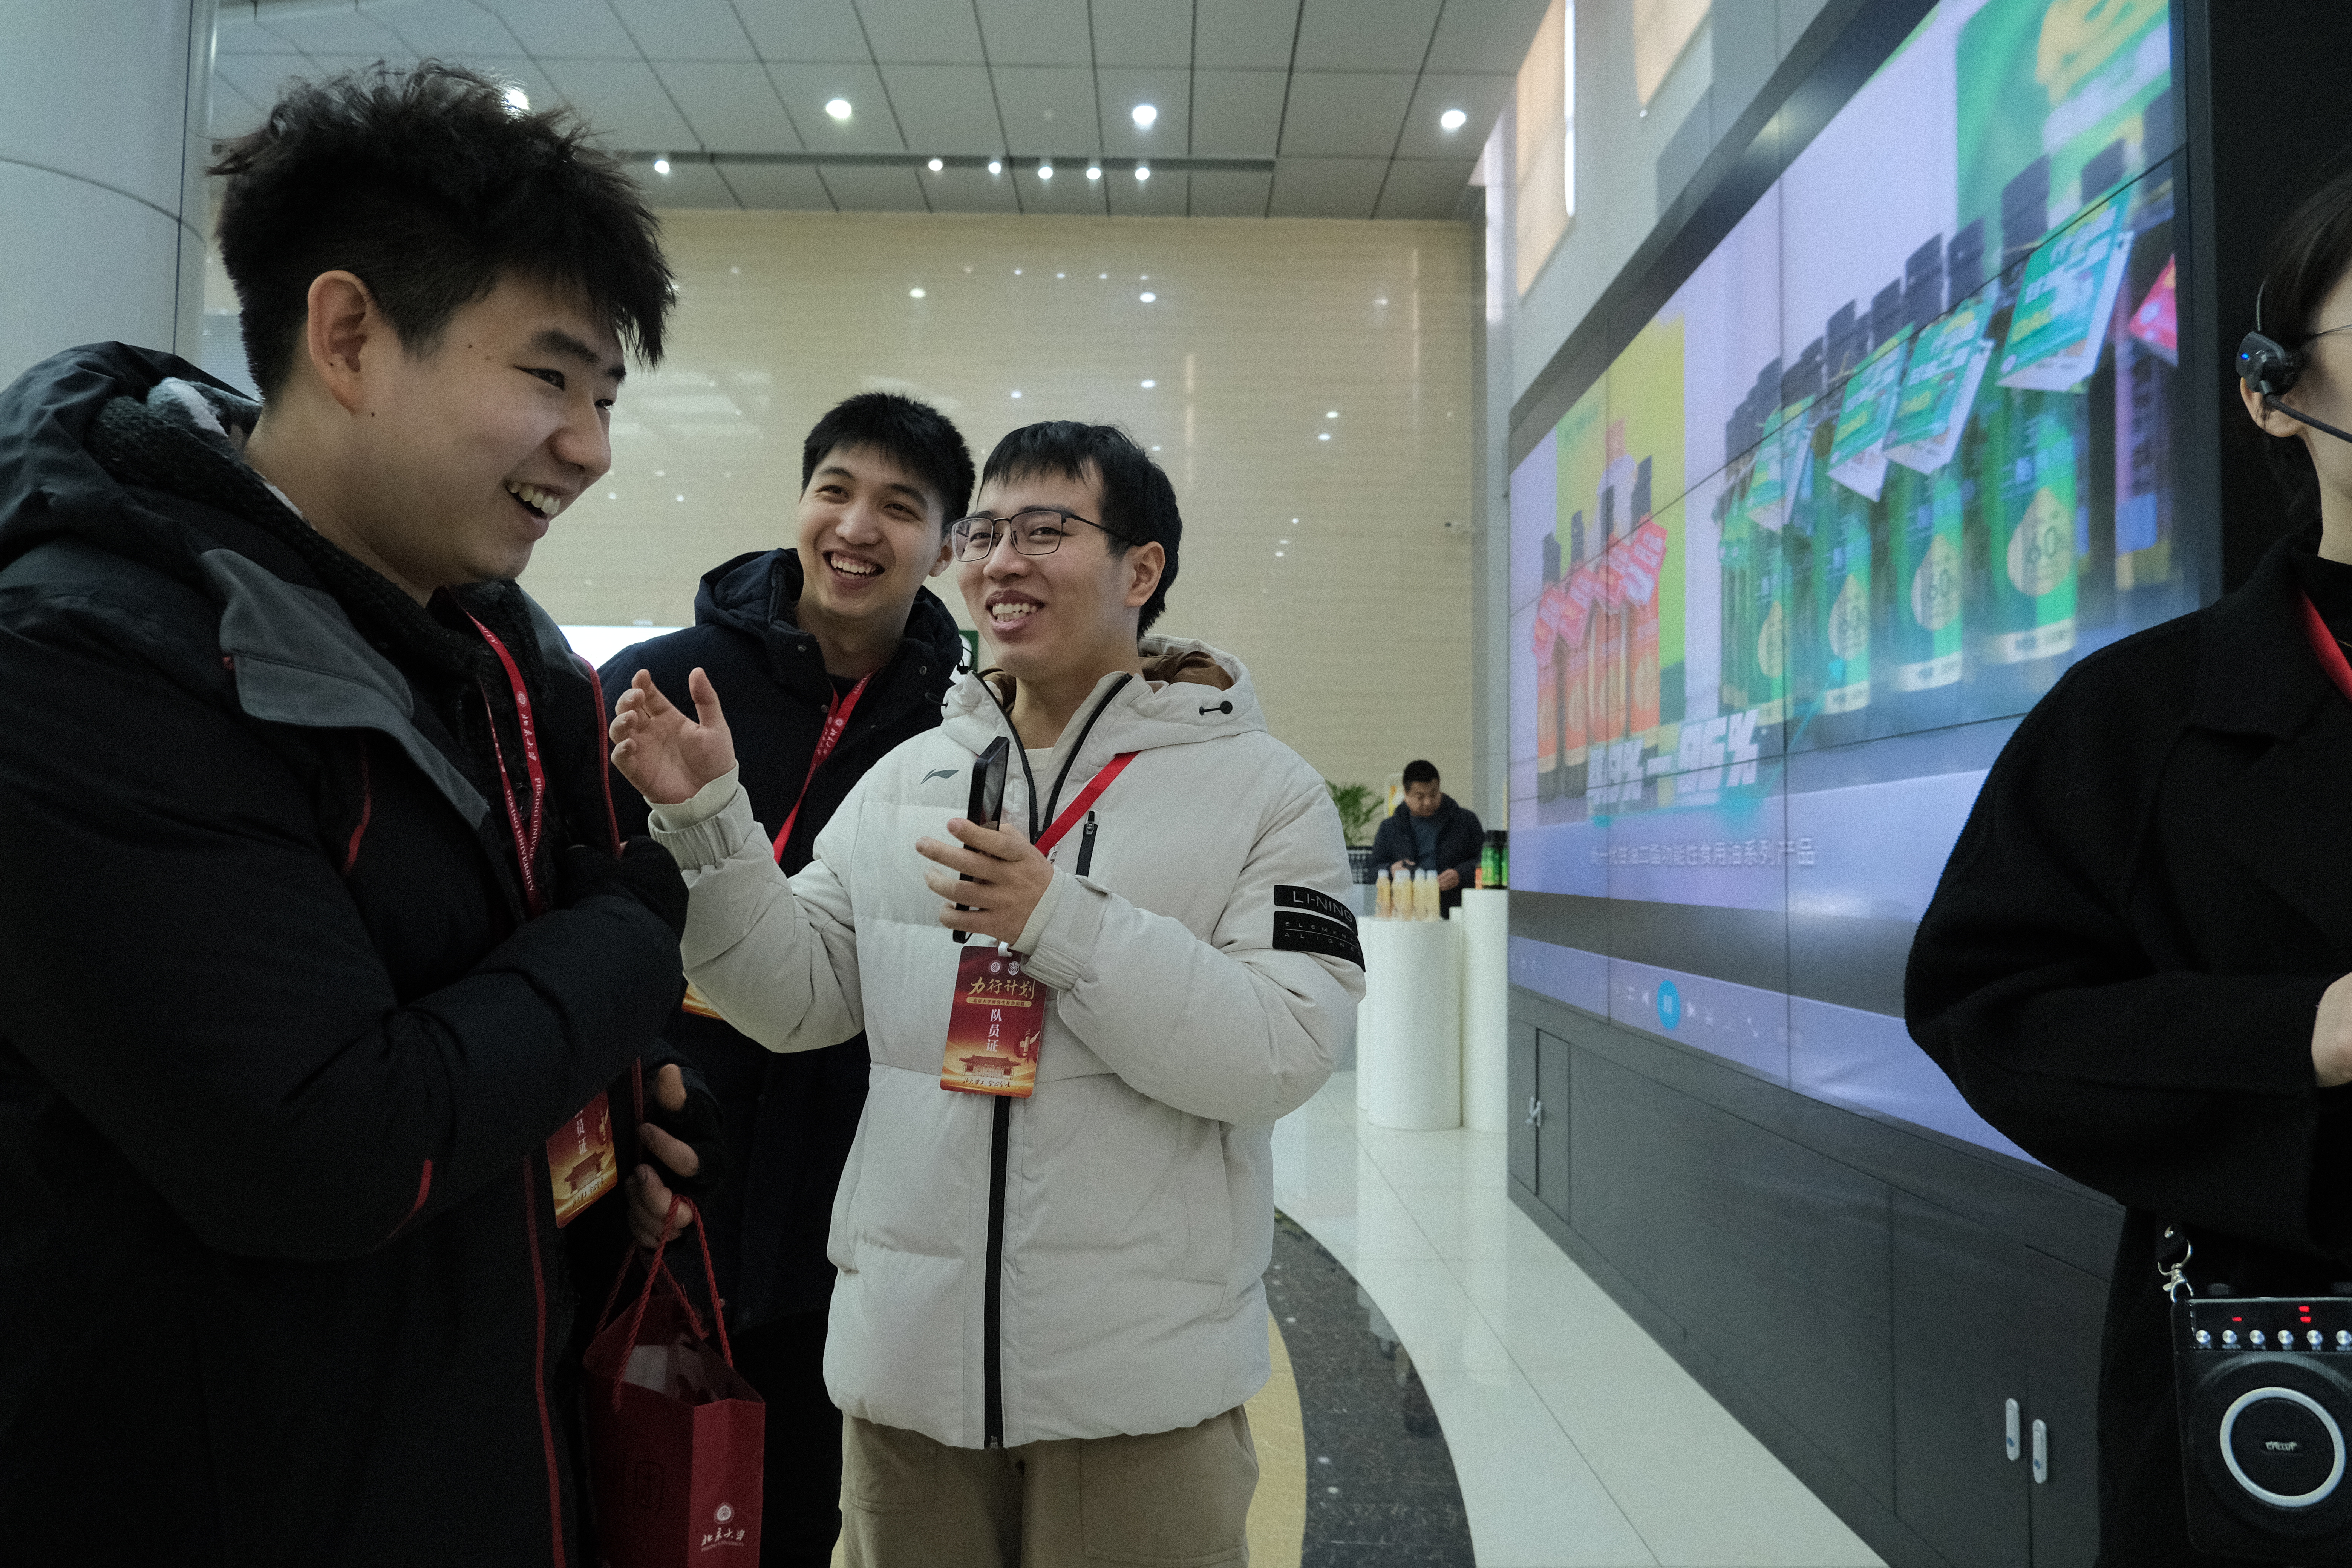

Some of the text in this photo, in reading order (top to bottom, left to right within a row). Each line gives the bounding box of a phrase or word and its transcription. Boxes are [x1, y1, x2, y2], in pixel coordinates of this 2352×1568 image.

[507, 789, 534, 892] PEKING UNIVERSITY
[529, 820, 538, 859] UNIVER
[1293, 891, 1352, 923] LI-NING
[1285, 922, 1358, 947] ELEMENT
[967, 977, 1035, 1000] 力行计划
[986, 1009, 1003, 1052] 队员证
[575, 1110, 588, 1155] 员证
